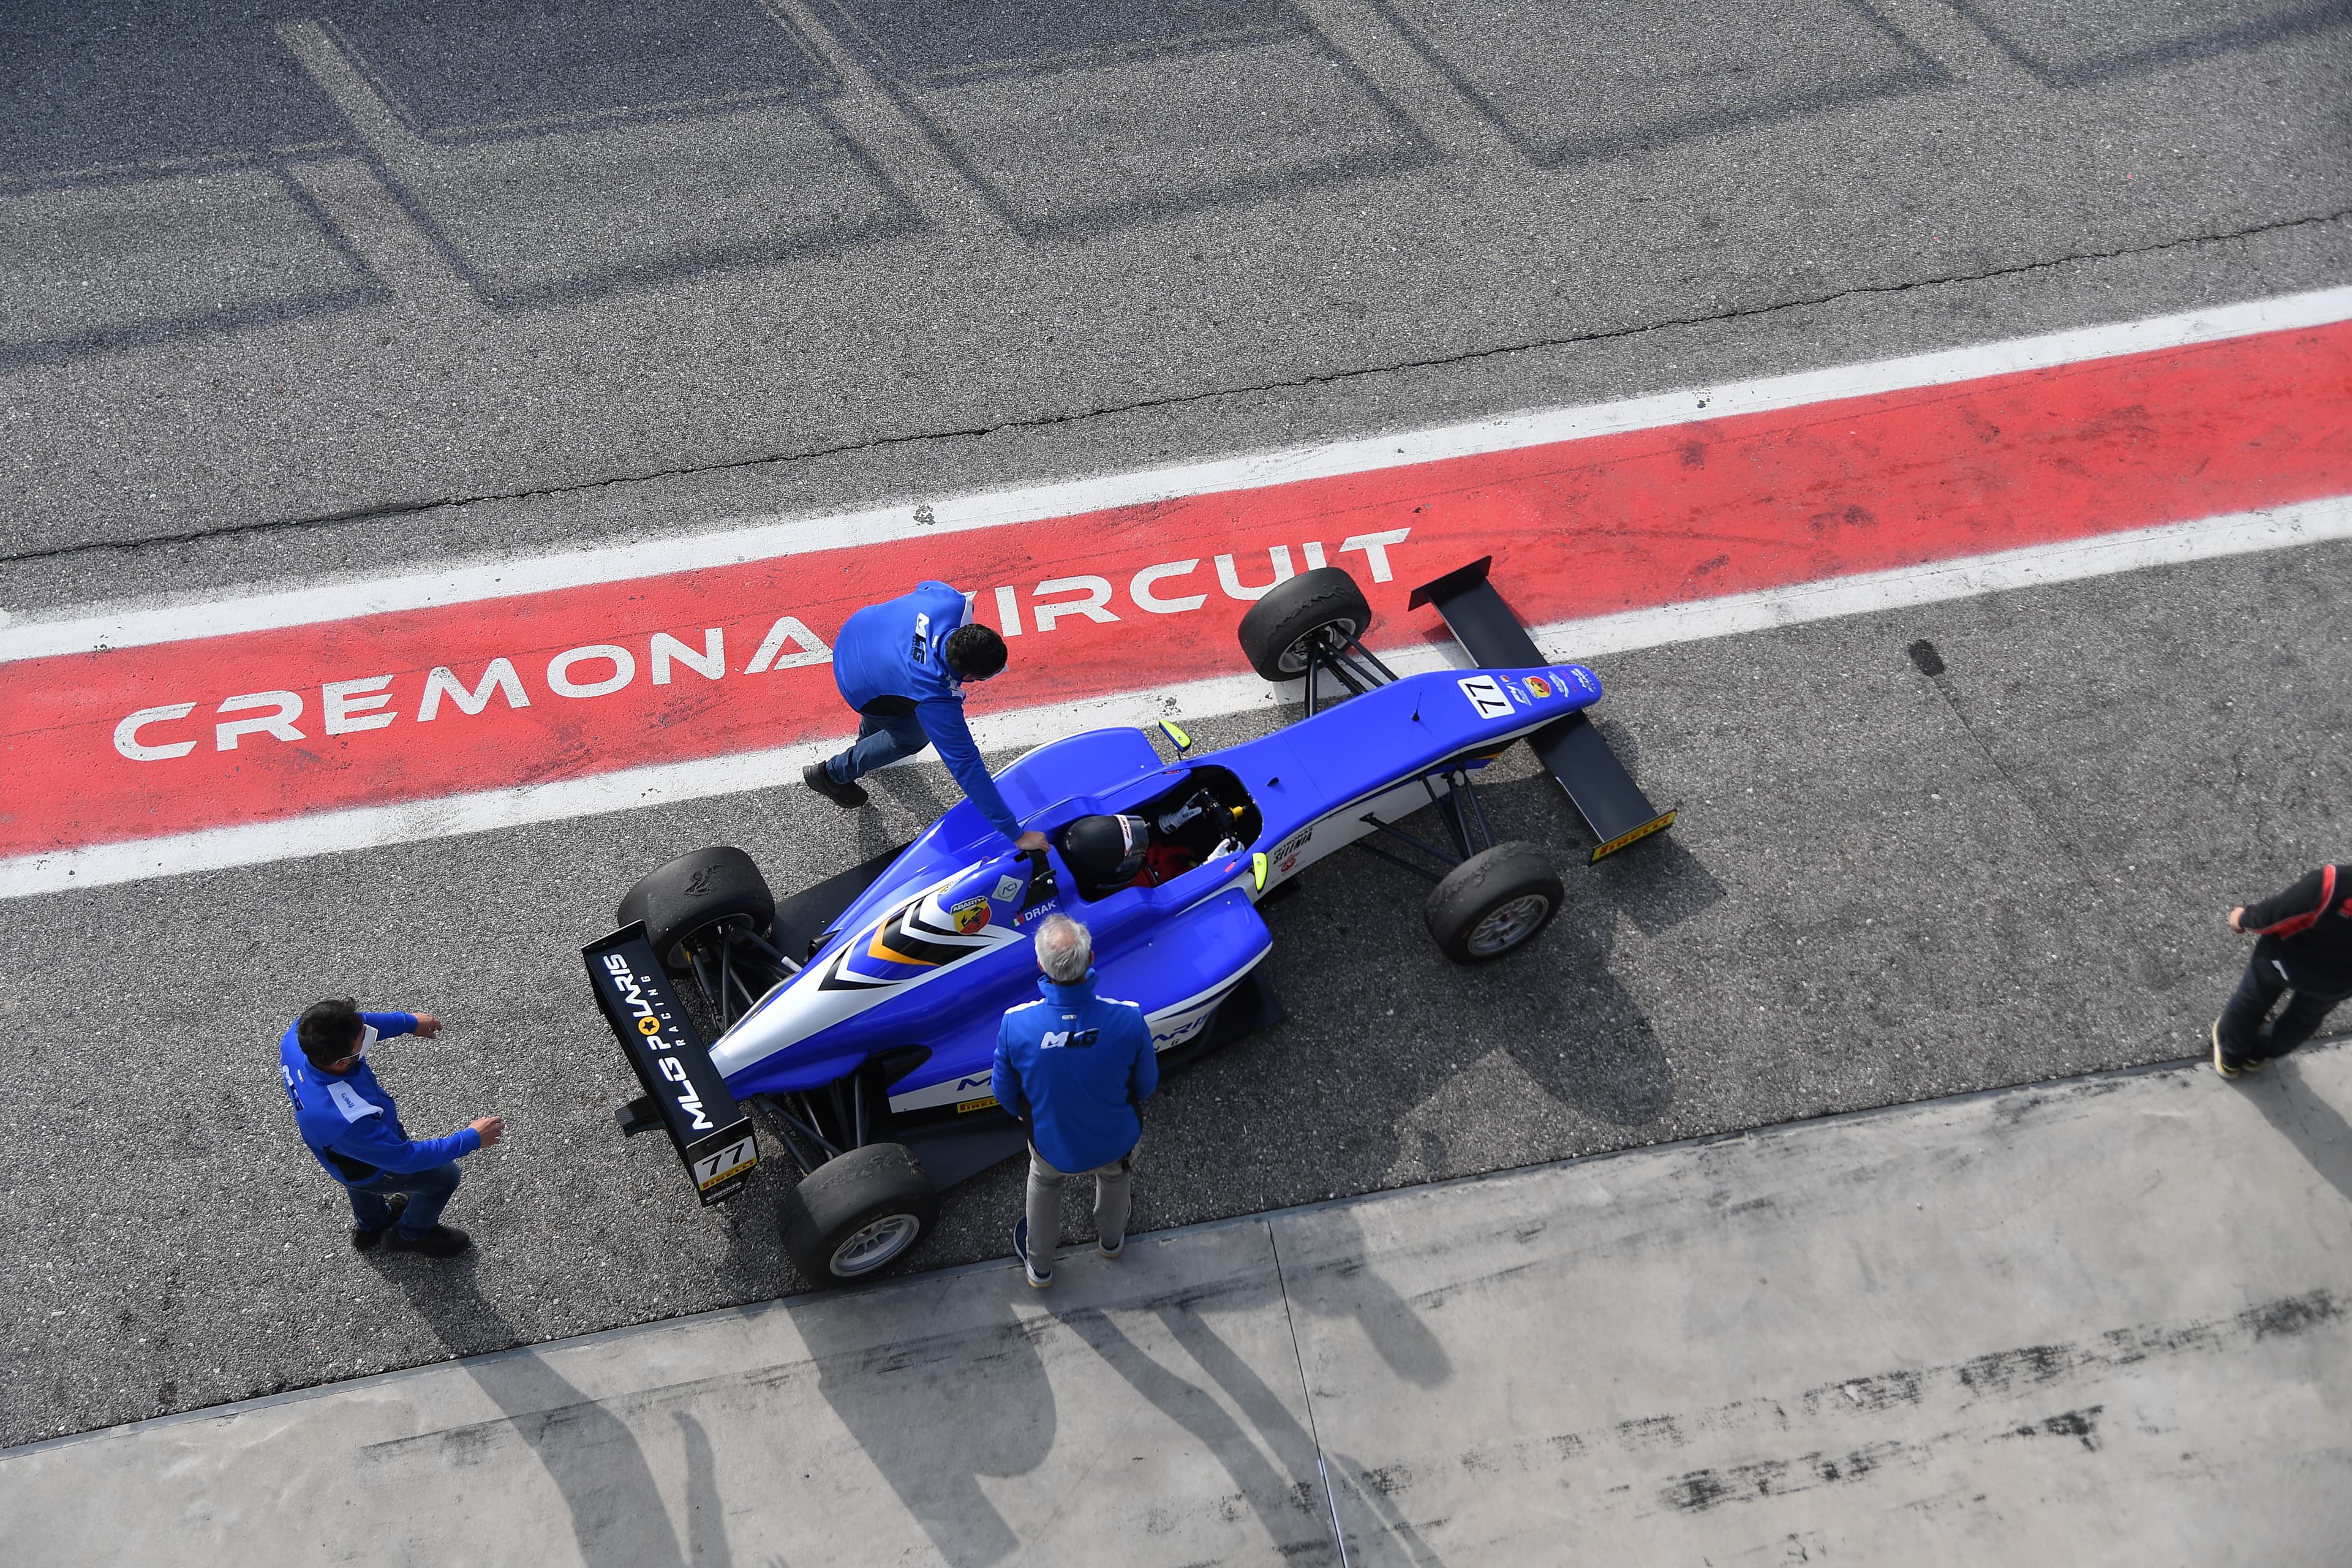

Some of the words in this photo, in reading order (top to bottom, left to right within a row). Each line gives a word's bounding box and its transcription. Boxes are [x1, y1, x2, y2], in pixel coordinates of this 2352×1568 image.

[113, 616, 835, 762] CREMONA
[962, 527, 1412, 638] IRCUIT
[912, 612, 930, 665] MLG
[1464, 682, 1507, 714] 77
[952, 897, 986, 913] ABARTH
[1024, 899, 1057, 922] DRAK
[640, 974, 687, 1047] RACING
[658, 1056, 715, 1131] MLG
[701, 1142, 745, 1177] 77
